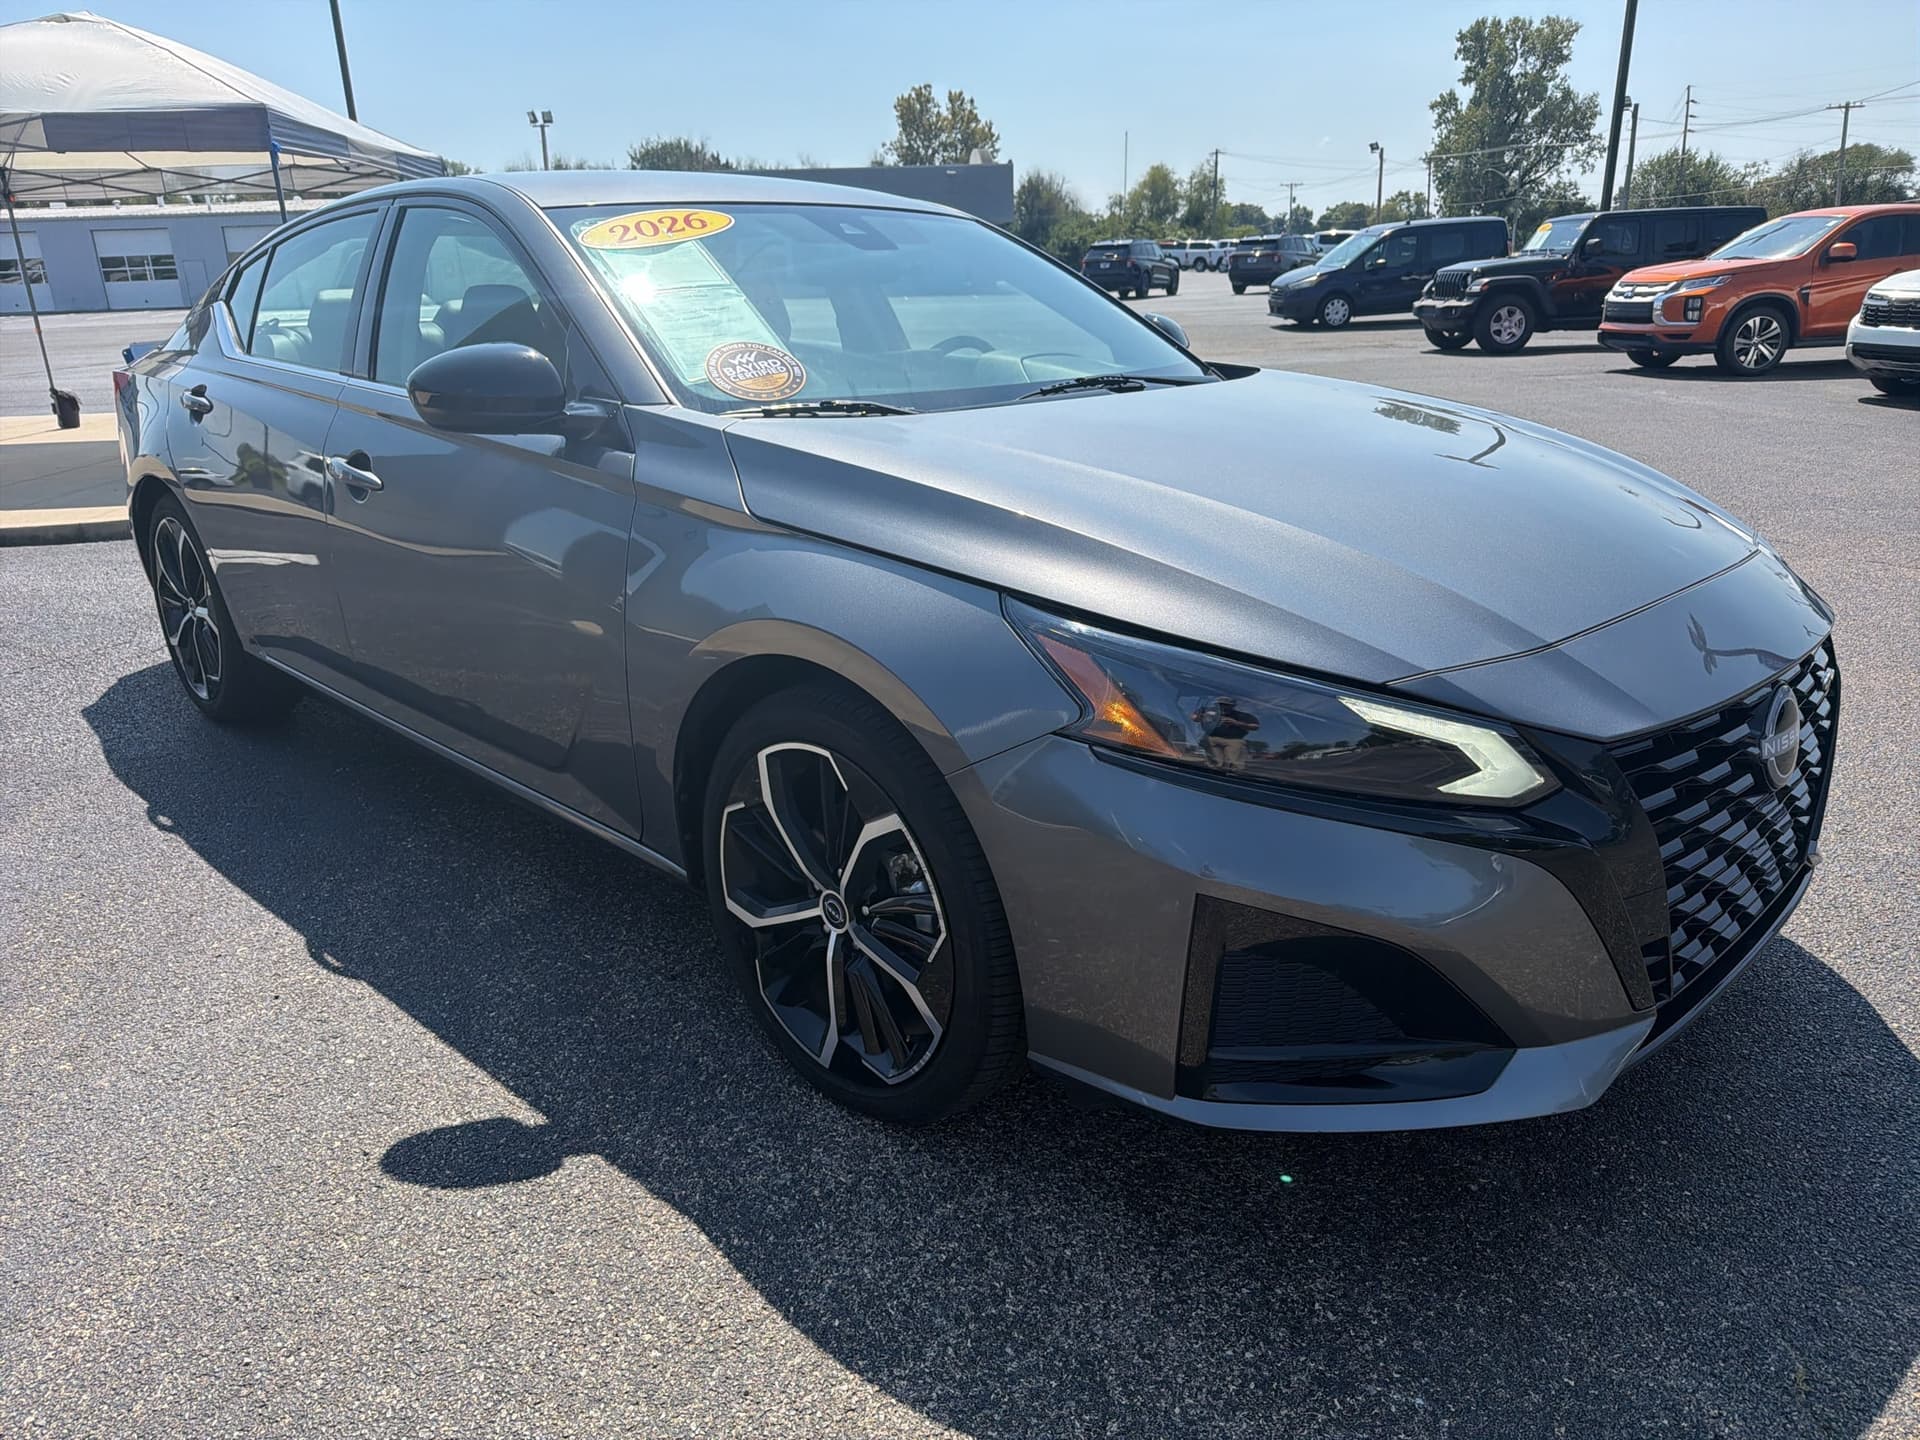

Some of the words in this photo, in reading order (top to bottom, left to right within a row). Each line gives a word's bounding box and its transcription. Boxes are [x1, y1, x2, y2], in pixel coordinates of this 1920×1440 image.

[608, 212, 708, 243] 2026
[767, 347, 783, 357] CAN
[722, 358, 781, 376] BAYIRD
[730, 366, 786, 381] CERTIFIED
[1764, 730, 1796, 756] NISS
